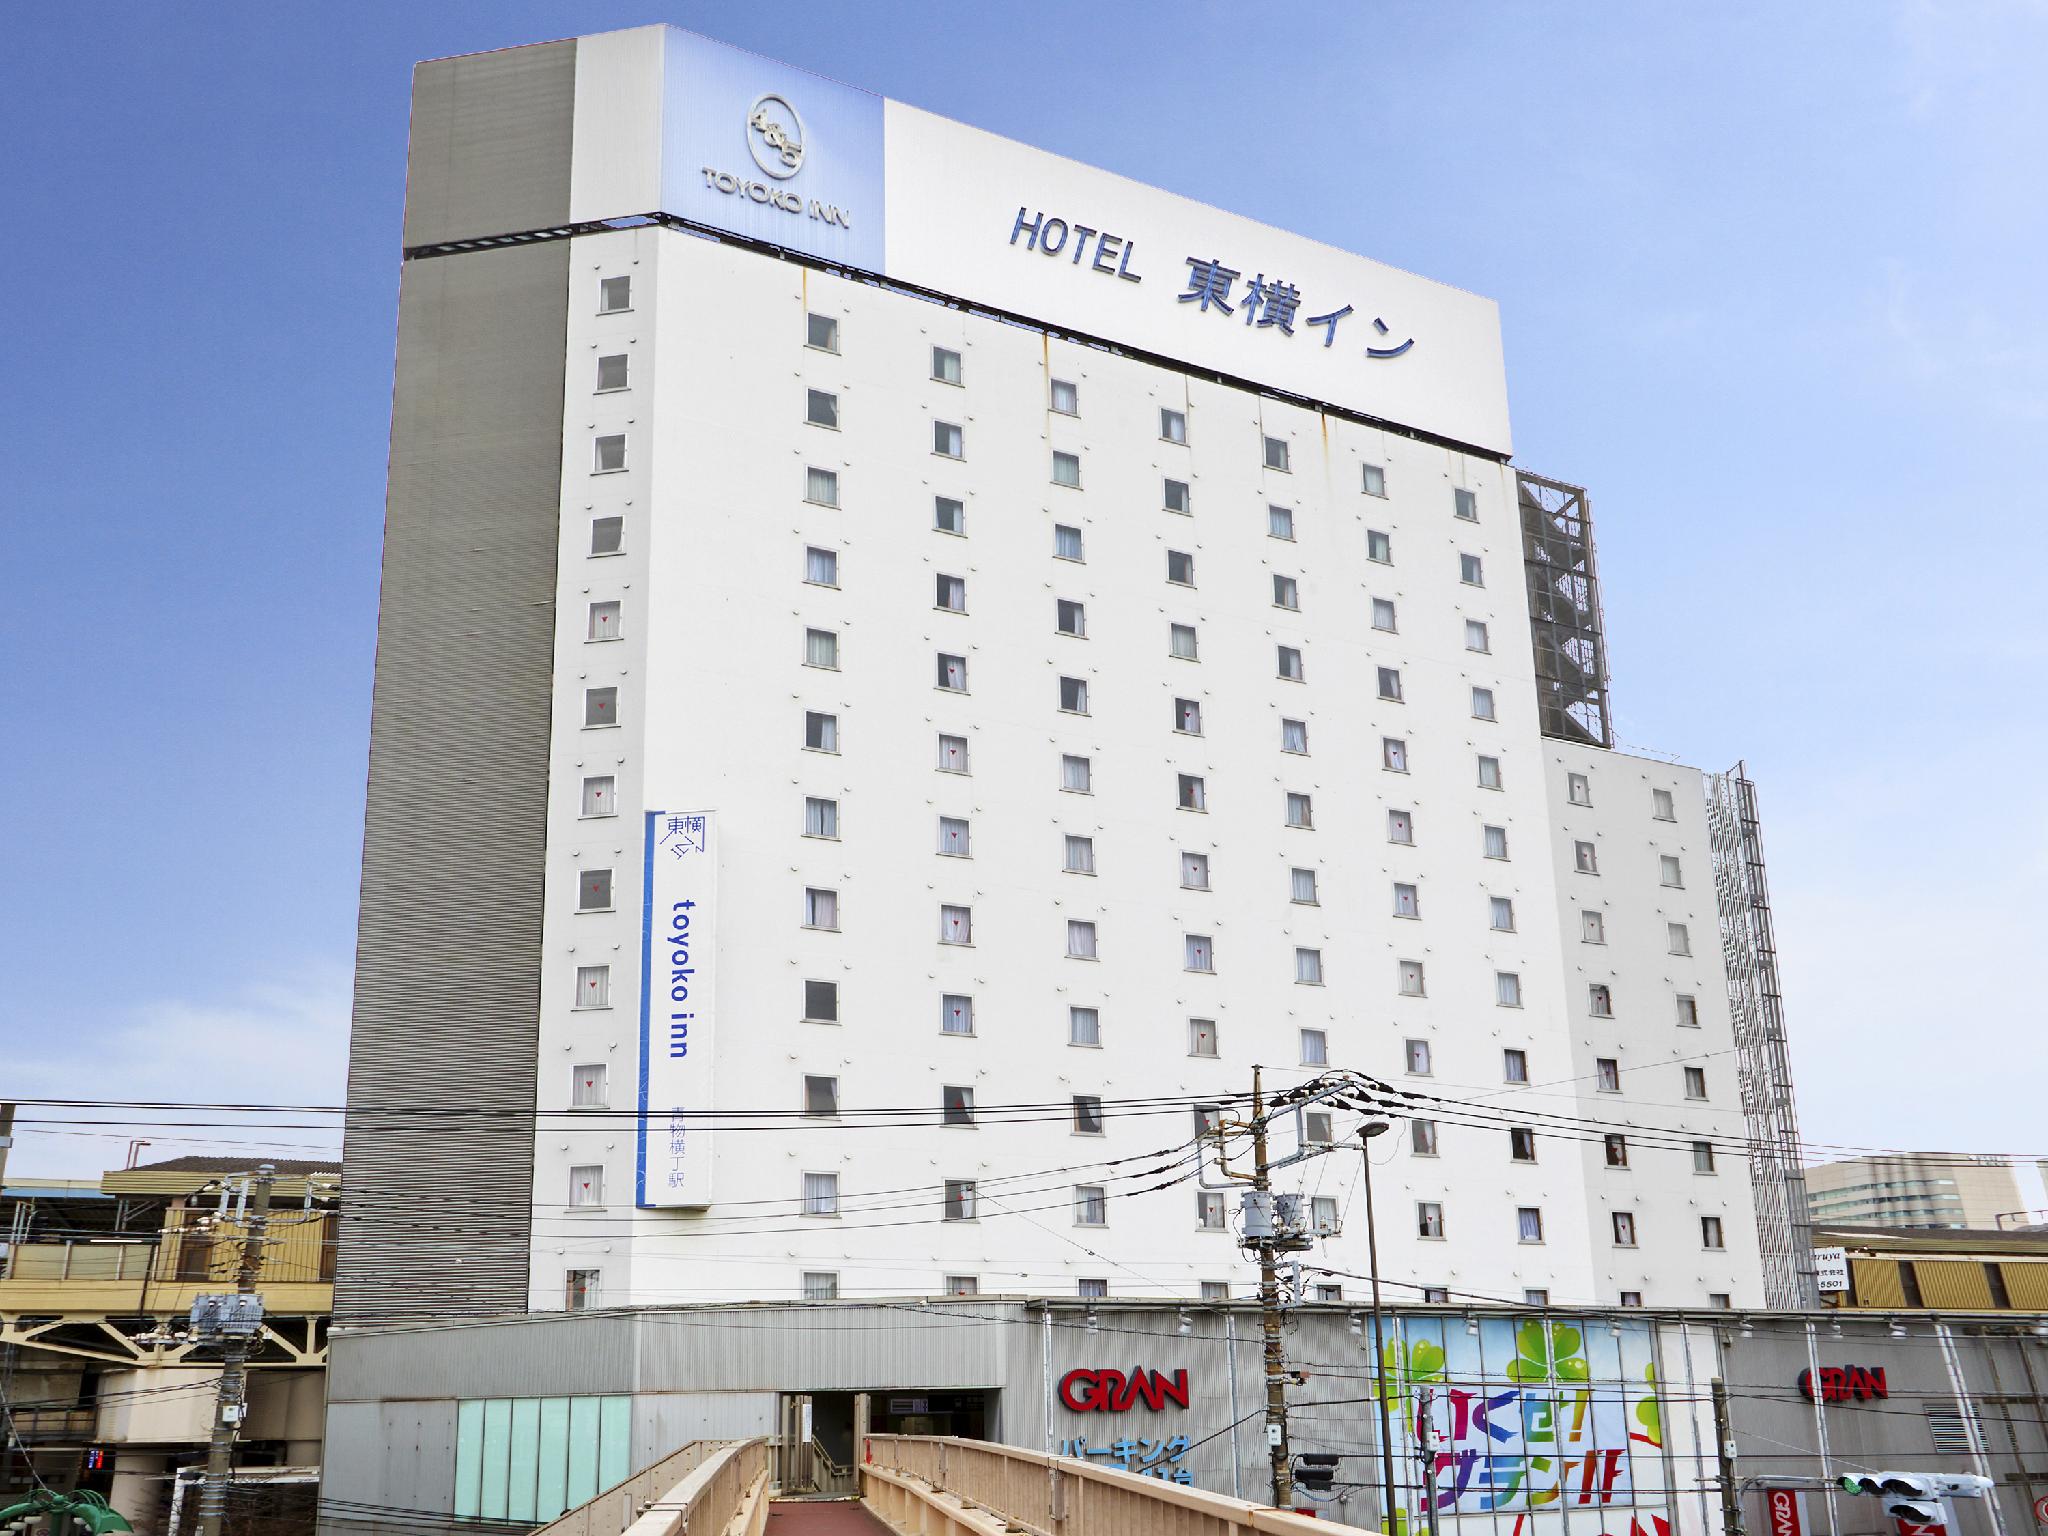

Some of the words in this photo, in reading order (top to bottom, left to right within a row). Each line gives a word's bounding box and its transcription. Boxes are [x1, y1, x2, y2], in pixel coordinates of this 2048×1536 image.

[702, 166, 803, 214] TOYOKO
[808, 199, 850, 230] INN
[1009, 206, 1142, 284] HOTEL
[1177, 256, 1415, 359] 東横イン
[667, 899, 697, 1002] toyoko
[670, 1013, 695, 1058] inn
[1059, 1365, 1190, 1412] GRAN
[1799, 1364, 1889, 1401] GRAN
[1061, 1435, 1191, 1464] パーキング
